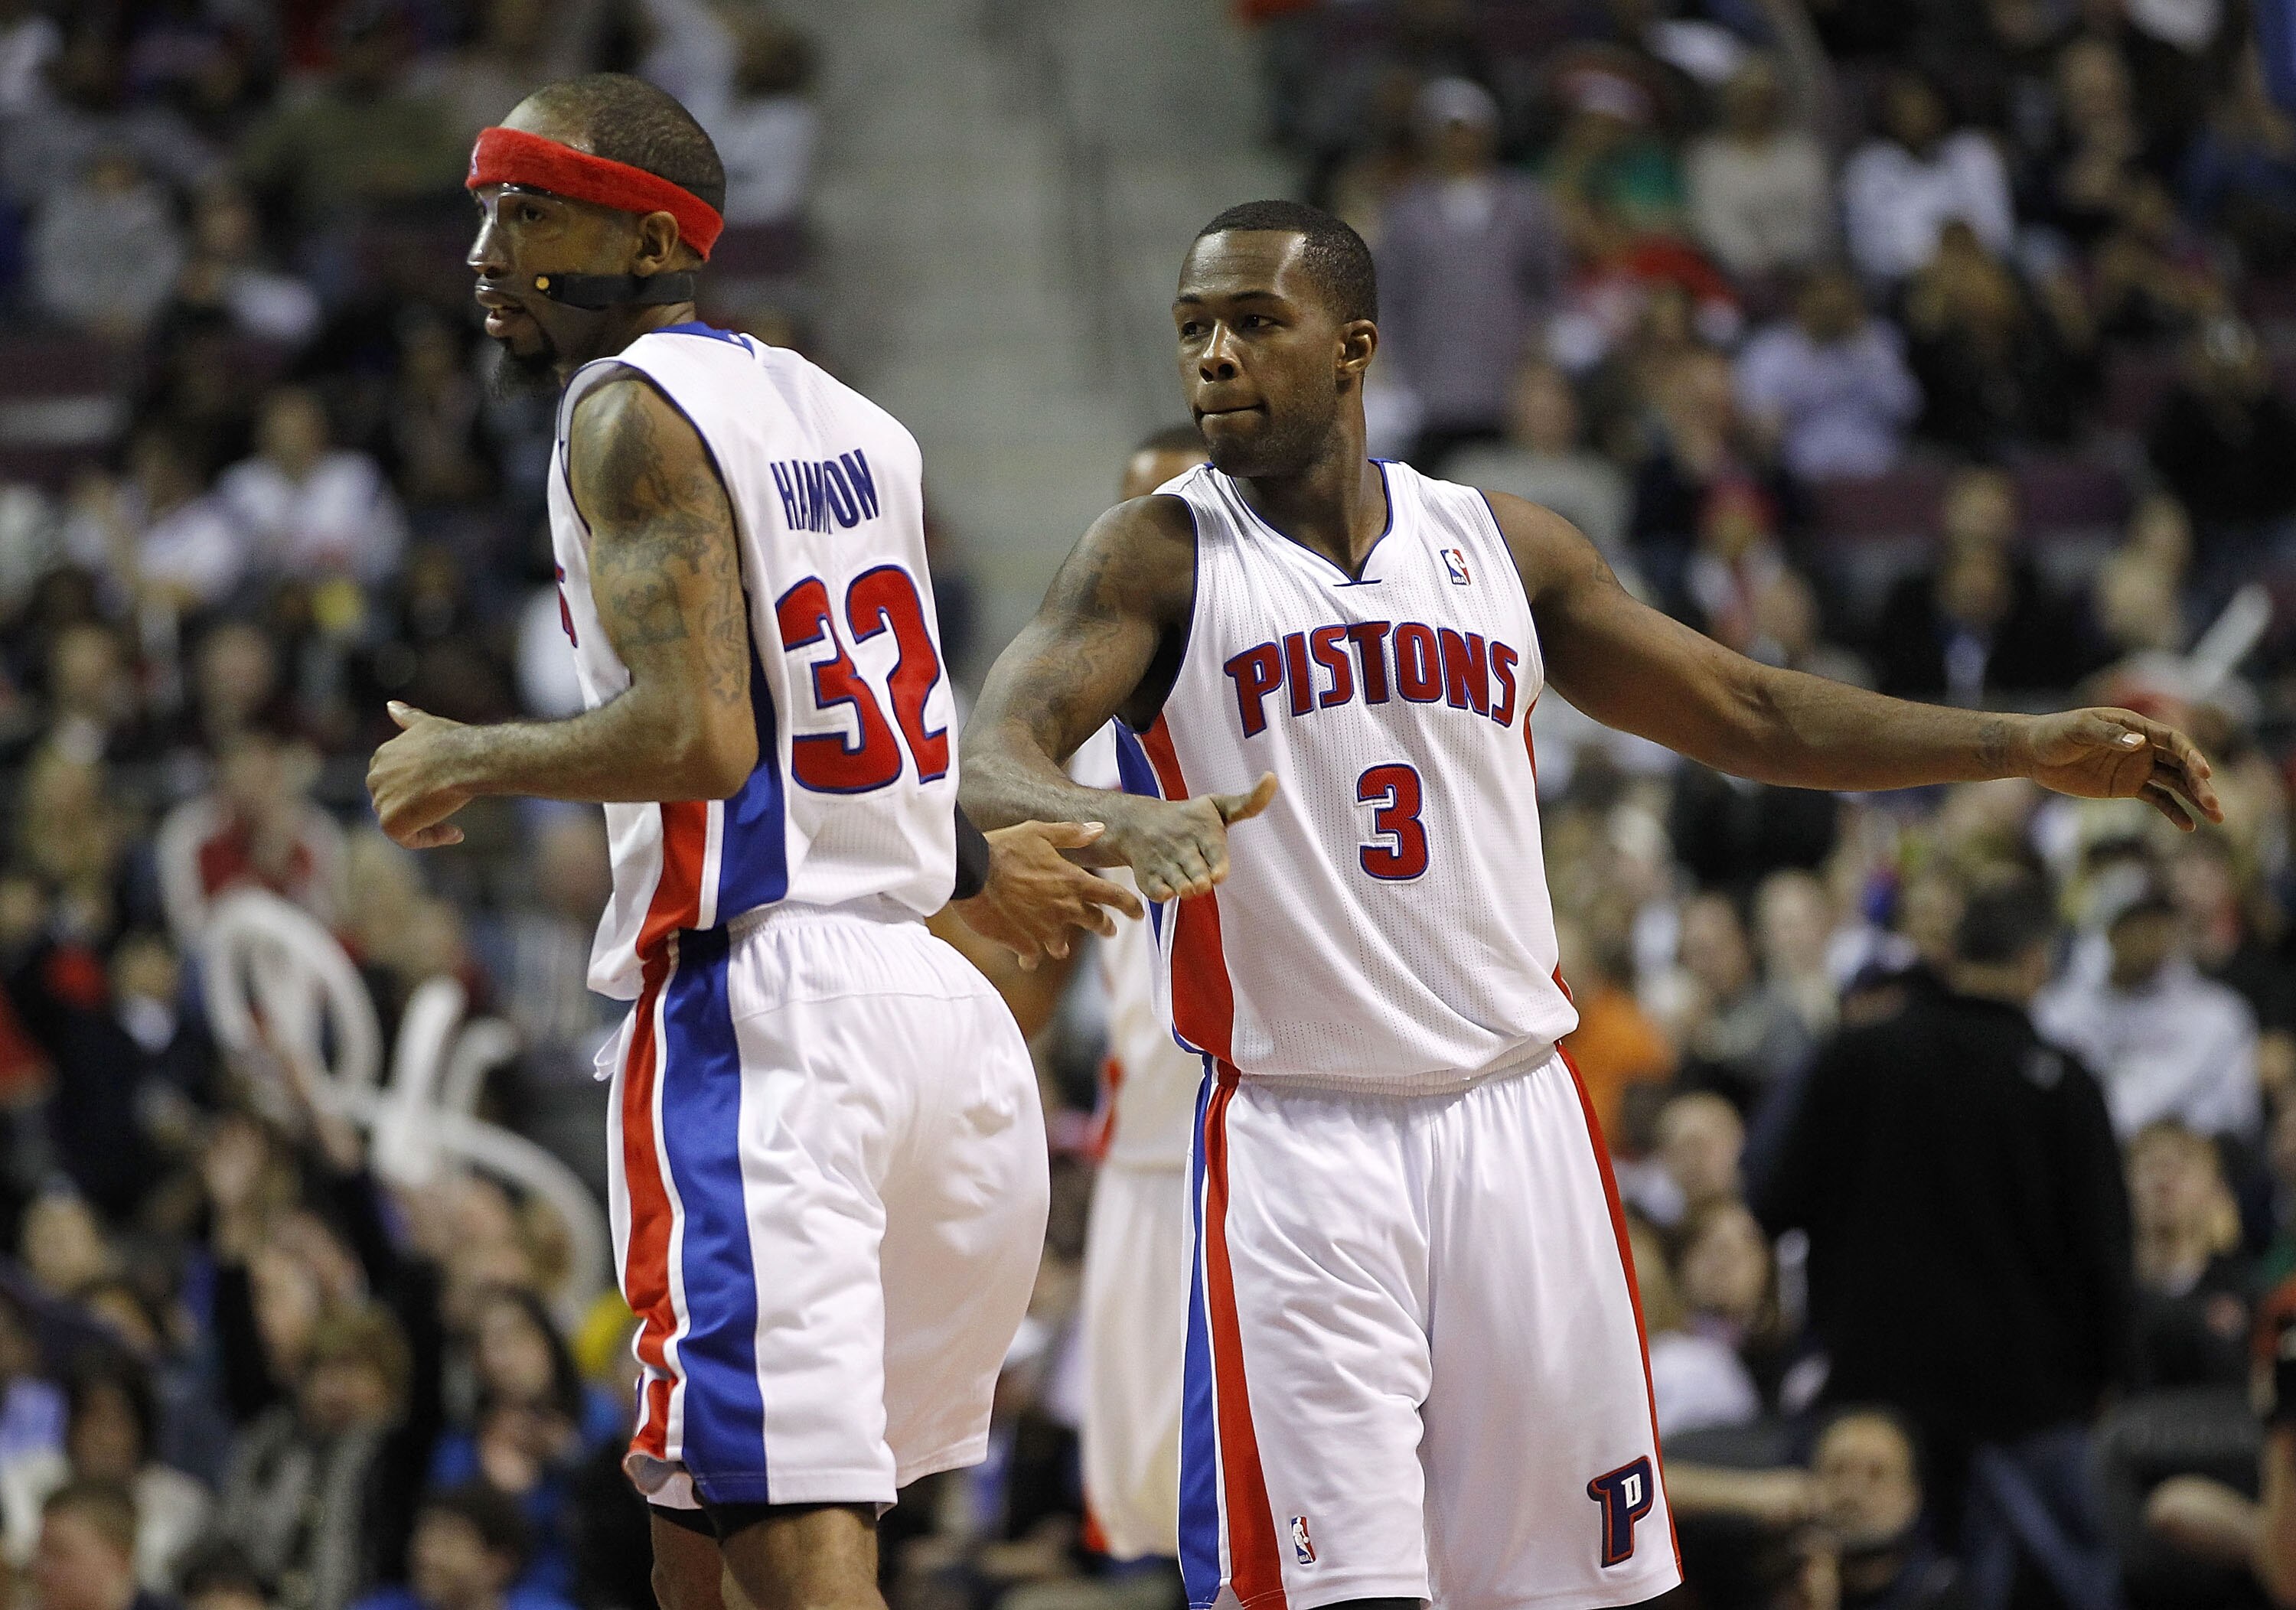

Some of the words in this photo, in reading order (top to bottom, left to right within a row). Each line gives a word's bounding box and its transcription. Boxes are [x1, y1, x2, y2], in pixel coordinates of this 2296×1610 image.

[775, 564, 949, 794] 32
[1224, 621, 1519, 738] PISTONS
[1357, 763, 1430, 881] 3
